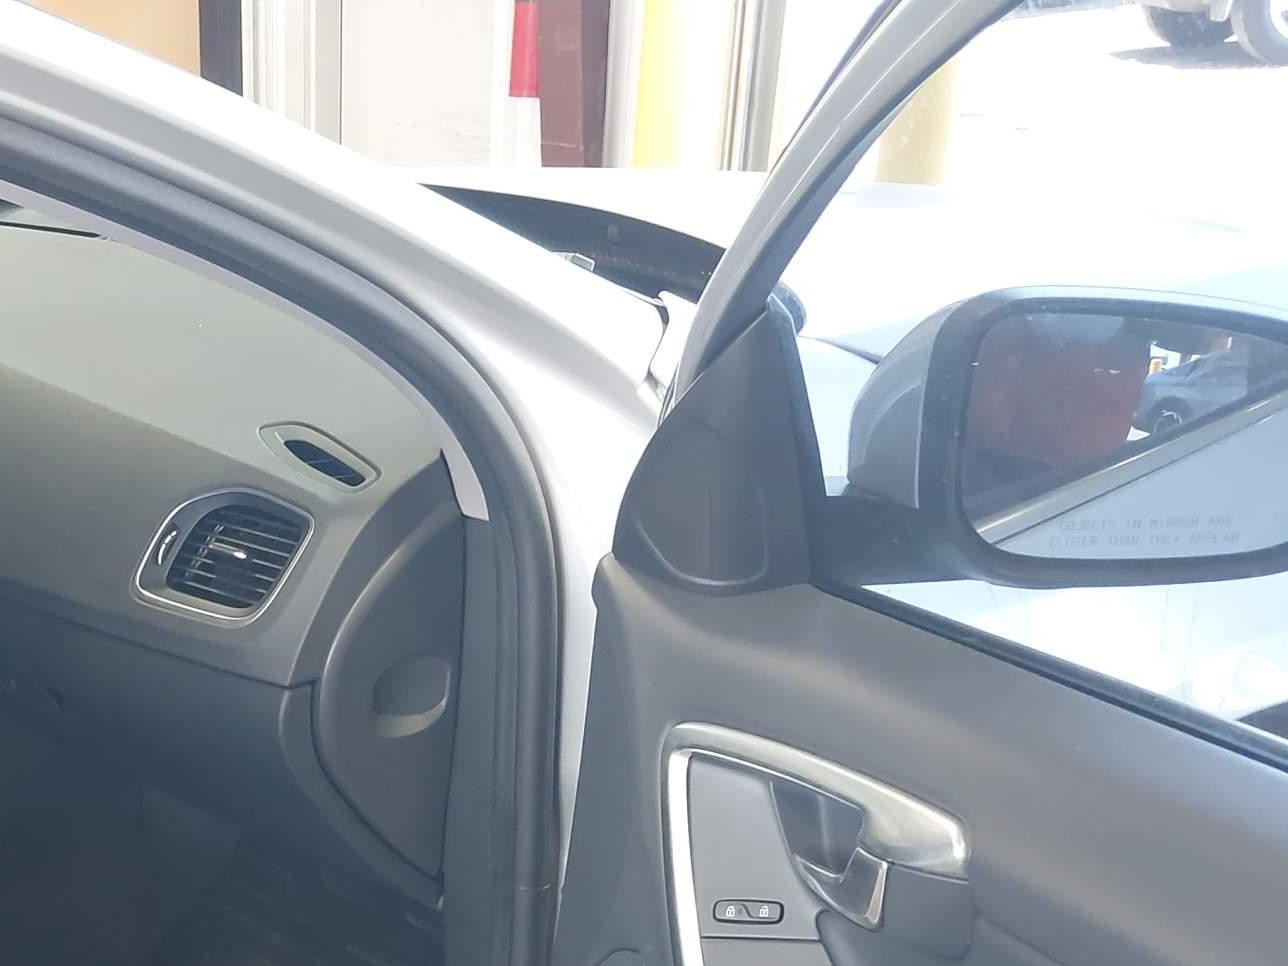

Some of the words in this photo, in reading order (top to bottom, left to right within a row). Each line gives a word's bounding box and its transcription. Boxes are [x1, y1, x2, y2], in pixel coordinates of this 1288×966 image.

[1127, 518, 1142, 530] IN
[1108, 534, 1140, 546] THAN
[1149, 533, 1180, 545] THEY
